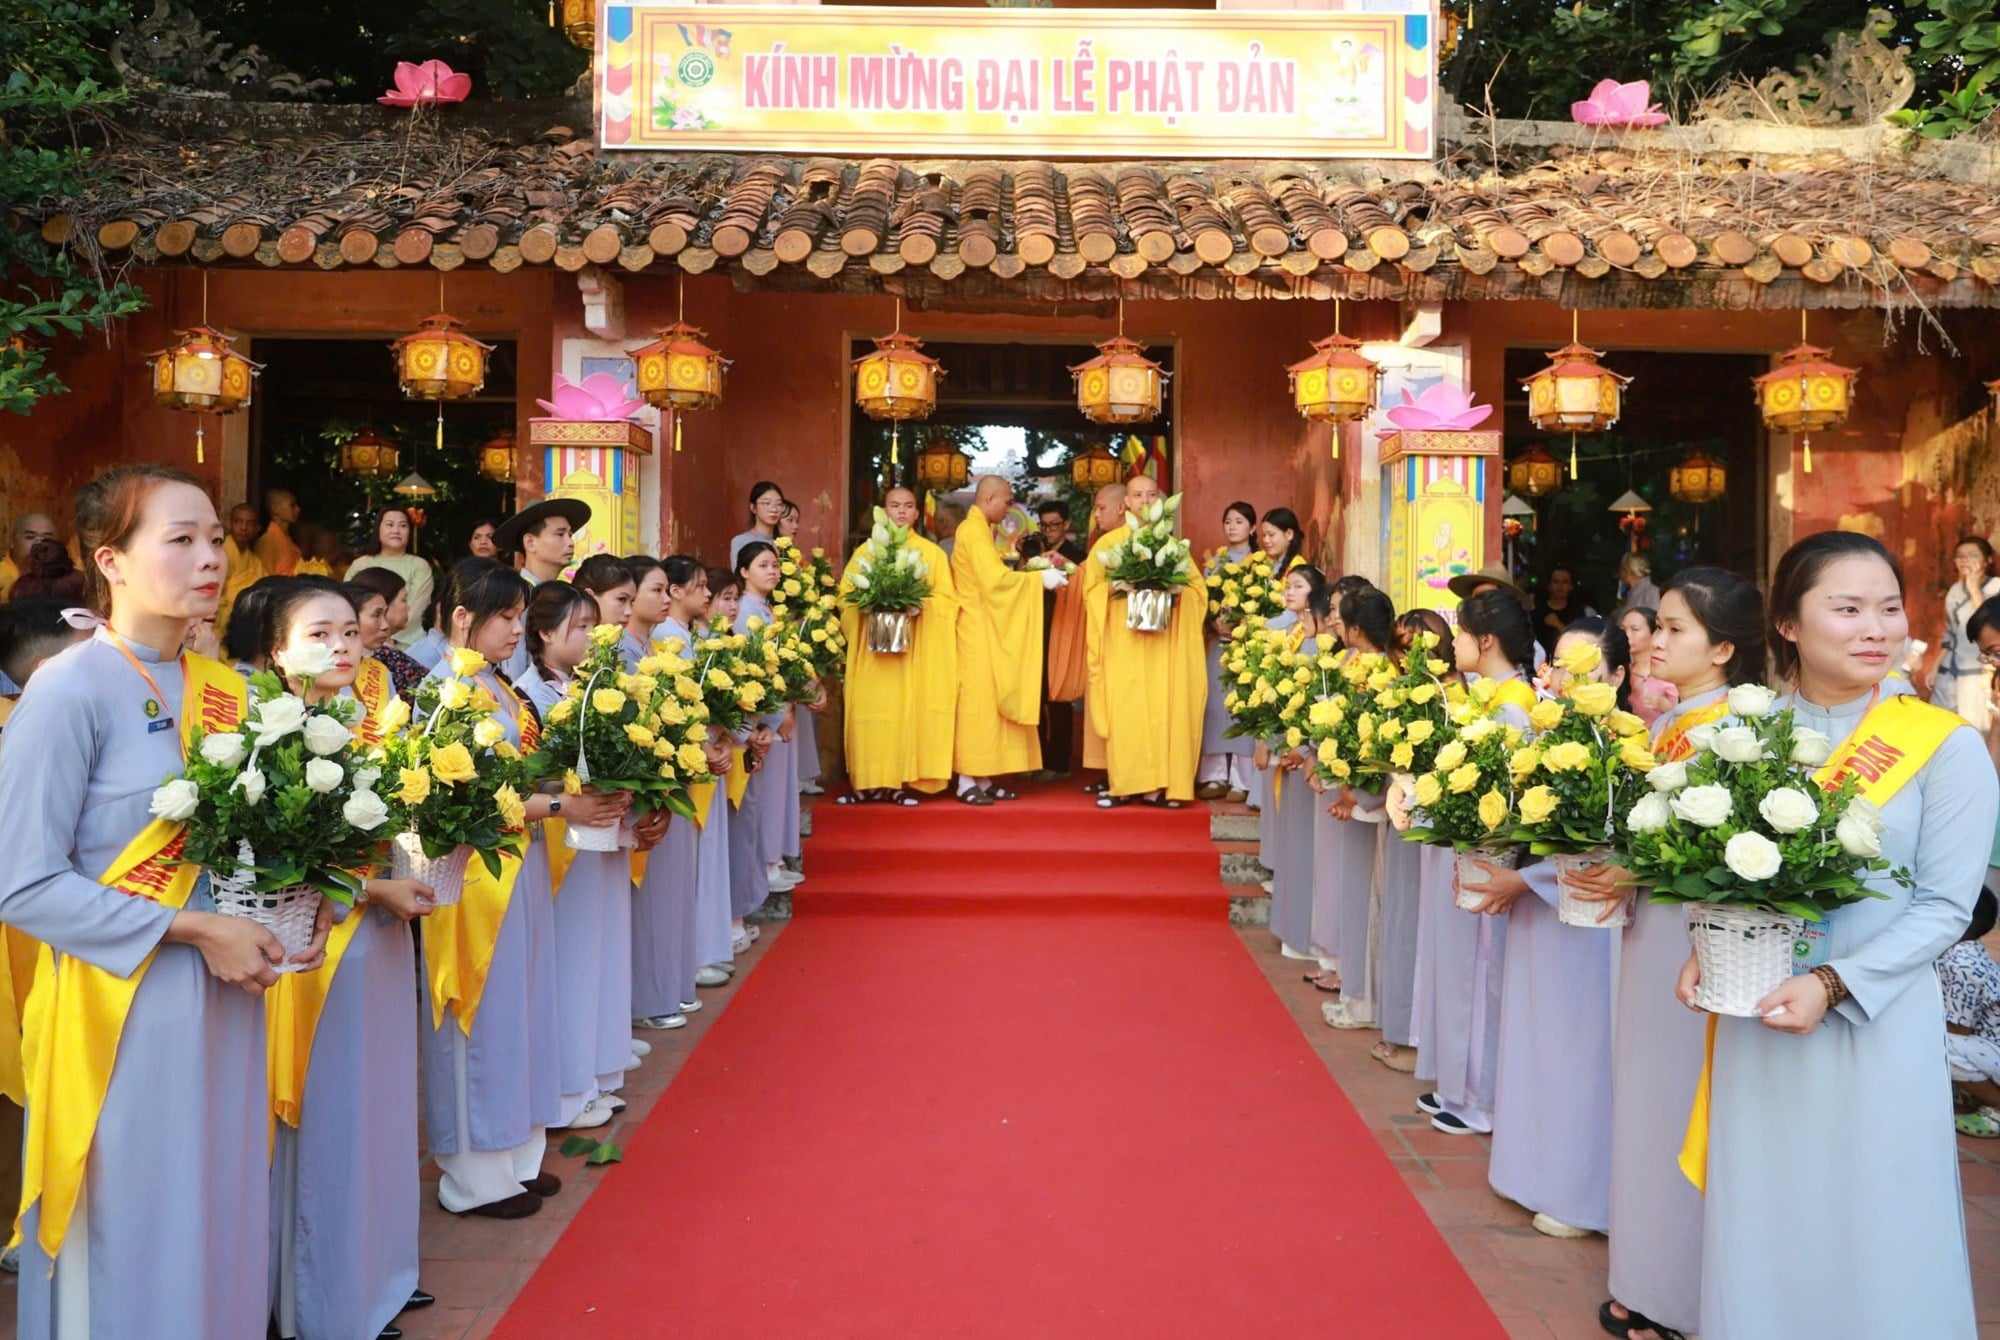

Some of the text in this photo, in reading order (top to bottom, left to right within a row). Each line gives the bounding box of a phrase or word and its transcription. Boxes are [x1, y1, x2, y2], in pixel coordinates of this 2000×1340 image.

[745, 44, 836, 109] KÍNH
[850, 46, 964, 111] MỪNG
[976, 59, 1039, 123] ĐẠI
[1053, 40, 1094, 112] LỄ
[1108, 49, 1205, 125] PHẬT
[1217, 43, 1294, 113] ĐẢN
